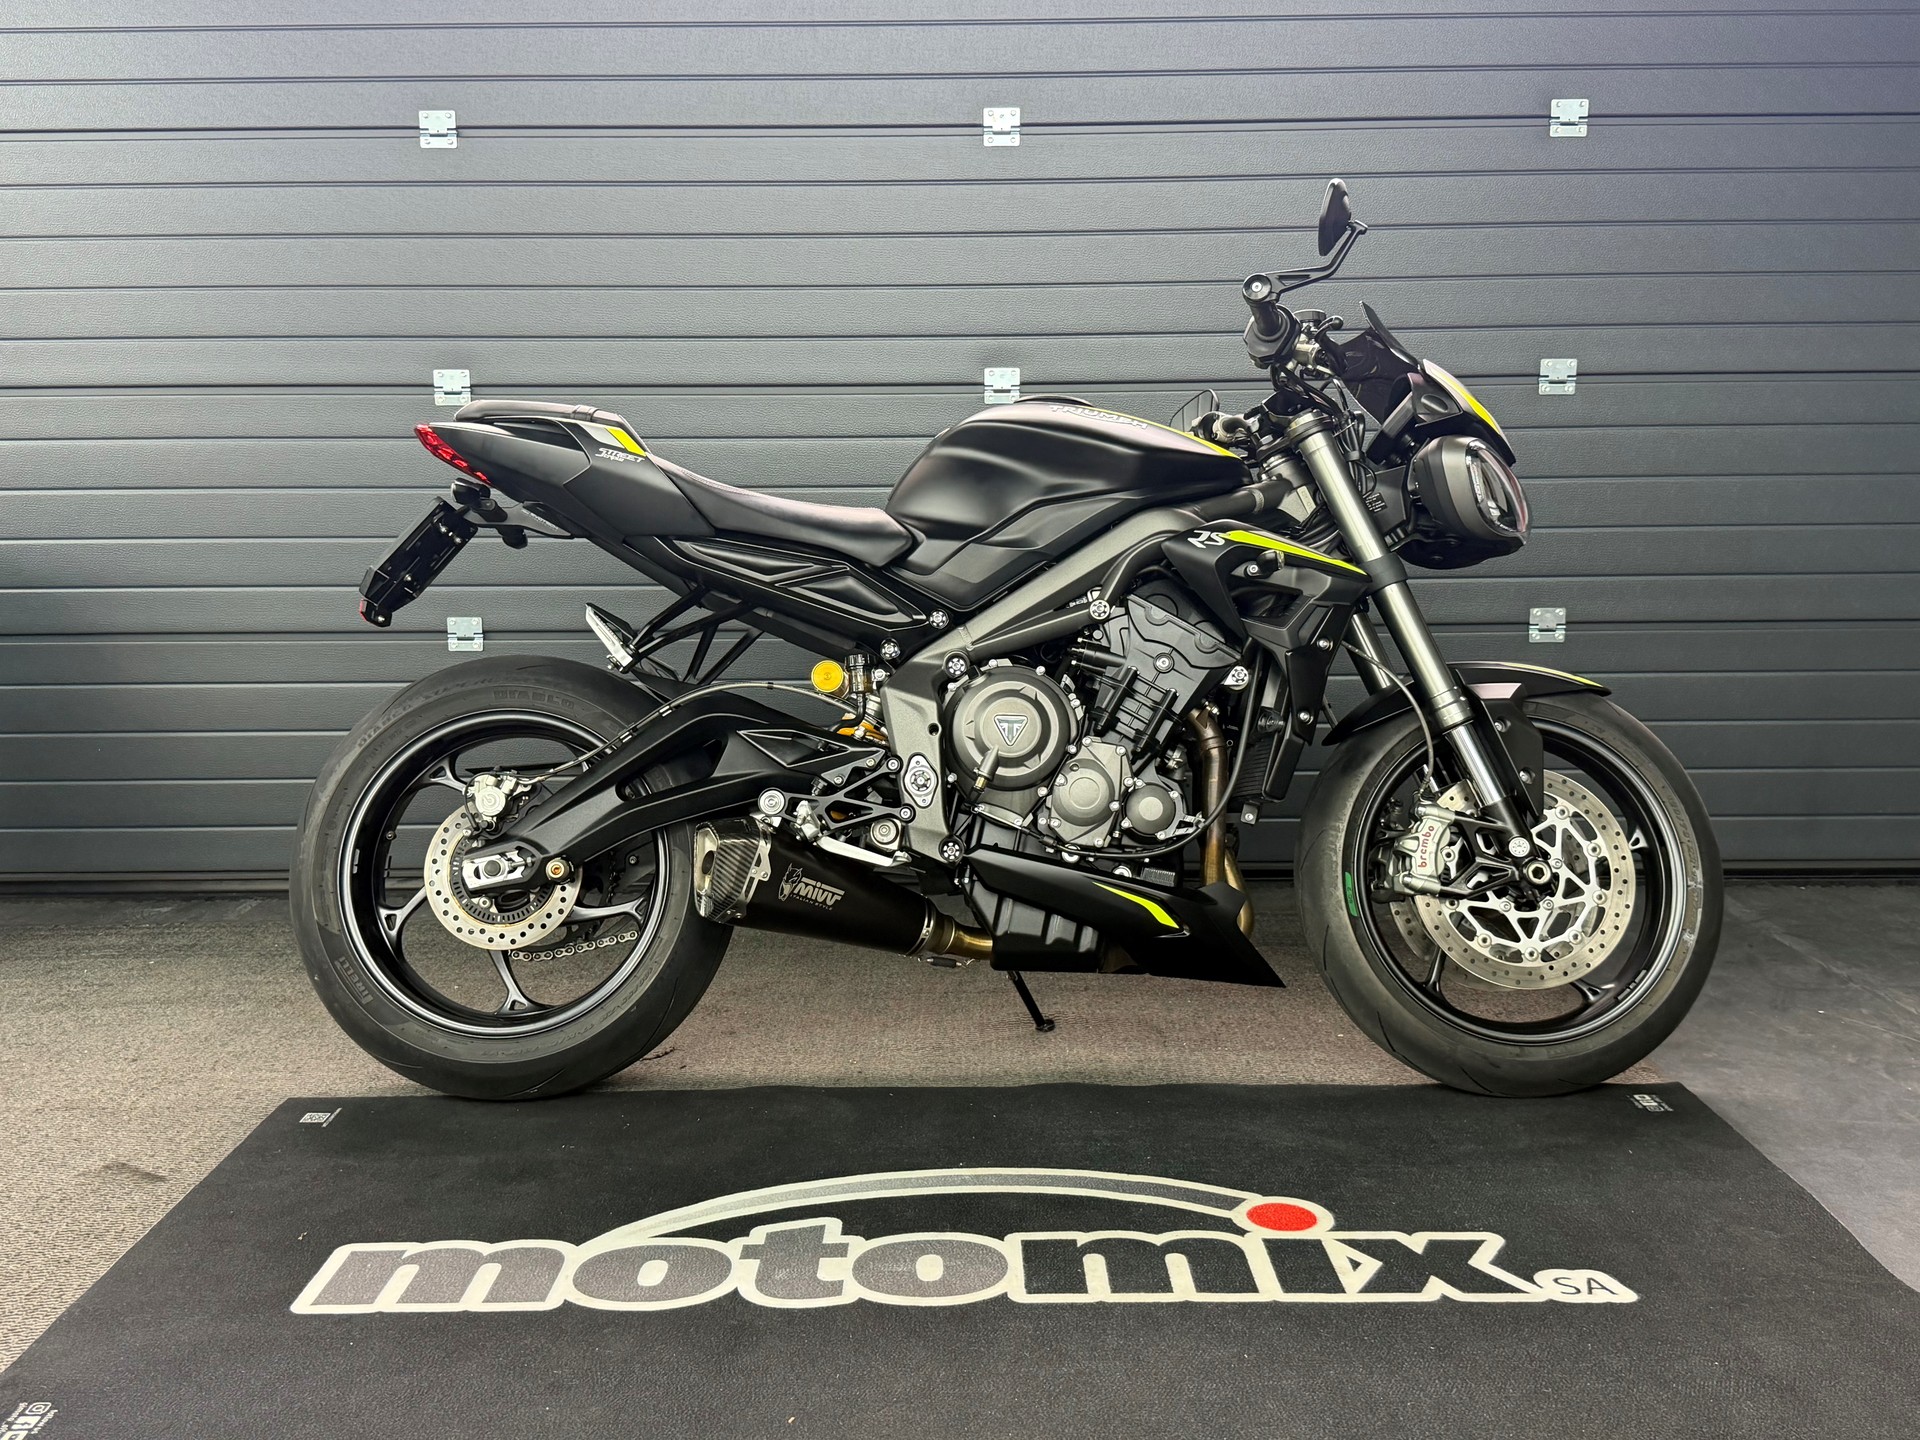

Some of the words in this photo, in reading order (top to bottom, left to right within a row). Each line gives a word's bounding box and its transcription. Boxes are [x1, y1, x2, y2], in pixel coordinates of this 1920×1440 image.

[1048, 405, 1148, 429] TRIUMPH
[1187, 530, 1226, 549] RS
[1417, 825, 1435, 868] brembo
[290, 1194, 1540, 1315] motomix
[1551, 1274, 1618, 1298] SA
